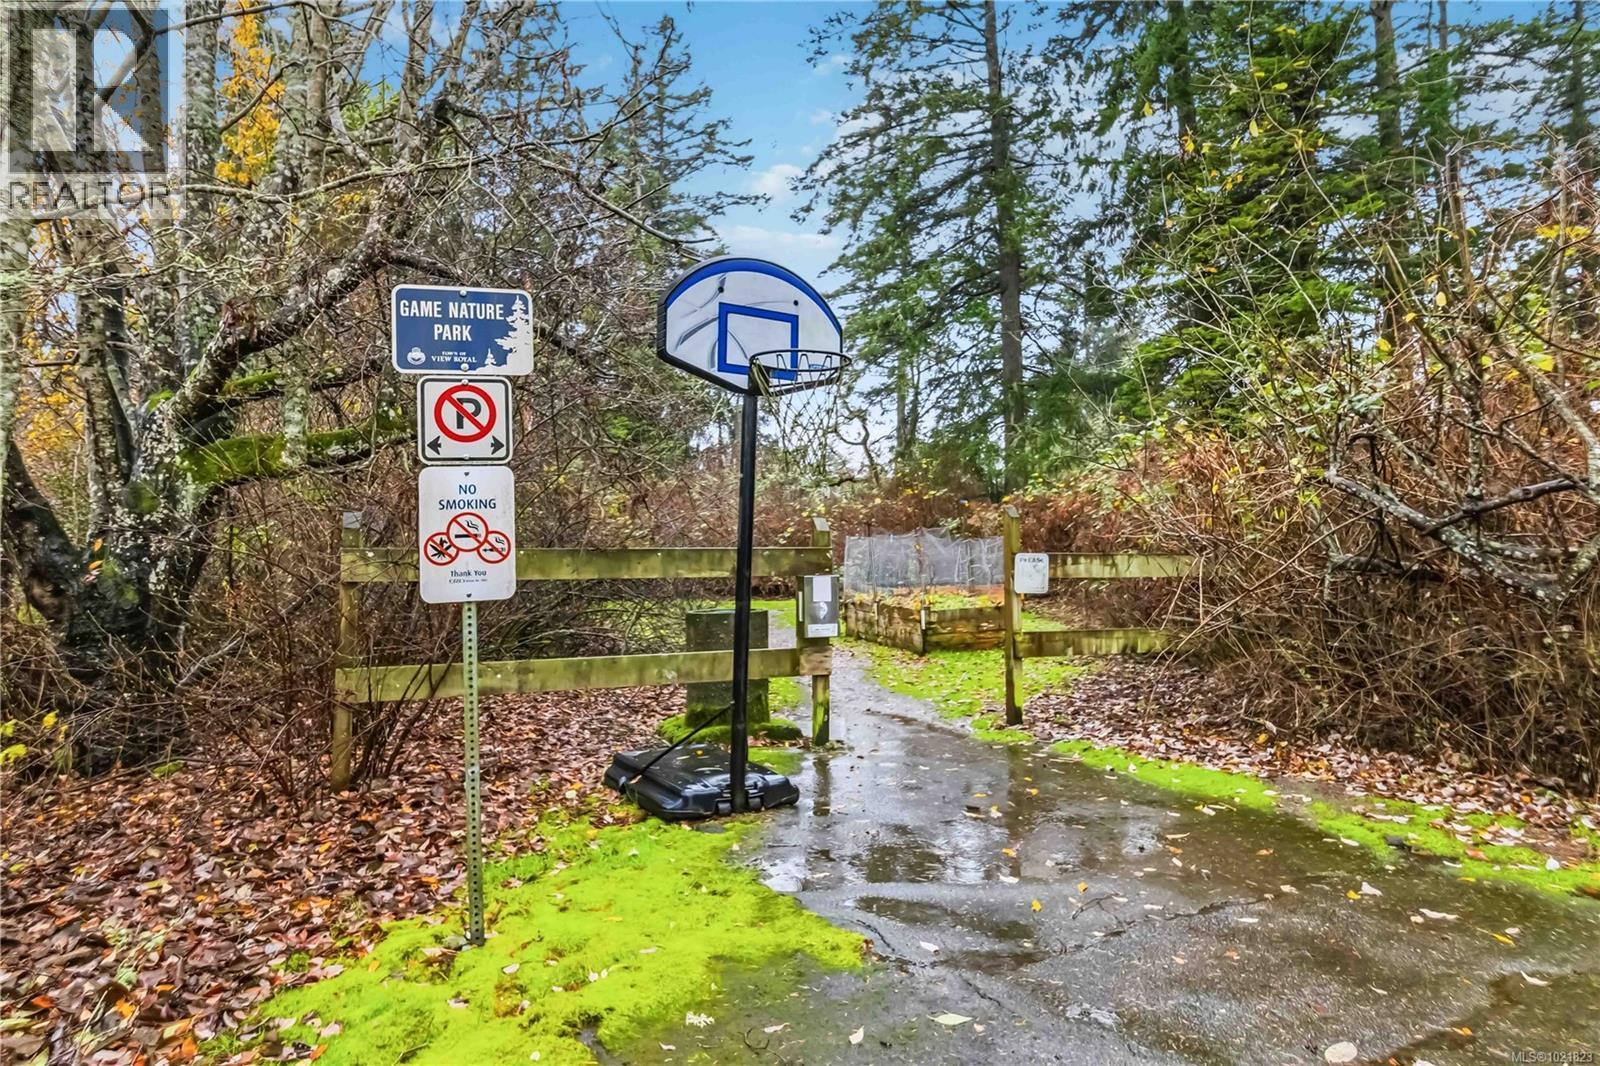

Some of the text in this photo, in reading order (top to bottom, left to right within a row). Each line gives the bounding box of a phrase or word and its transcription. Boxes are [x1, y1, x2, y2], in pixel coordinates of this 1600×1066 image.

[400, 300, 504, 320] GAME NATURE
[434, 324, 472, 341] PARK
[456, 397, 482, 430] P
[458, 484, 477, 495] NO
[438, 498, 497, 511] SMOKING
[450, 569, 471, 577] Thank
